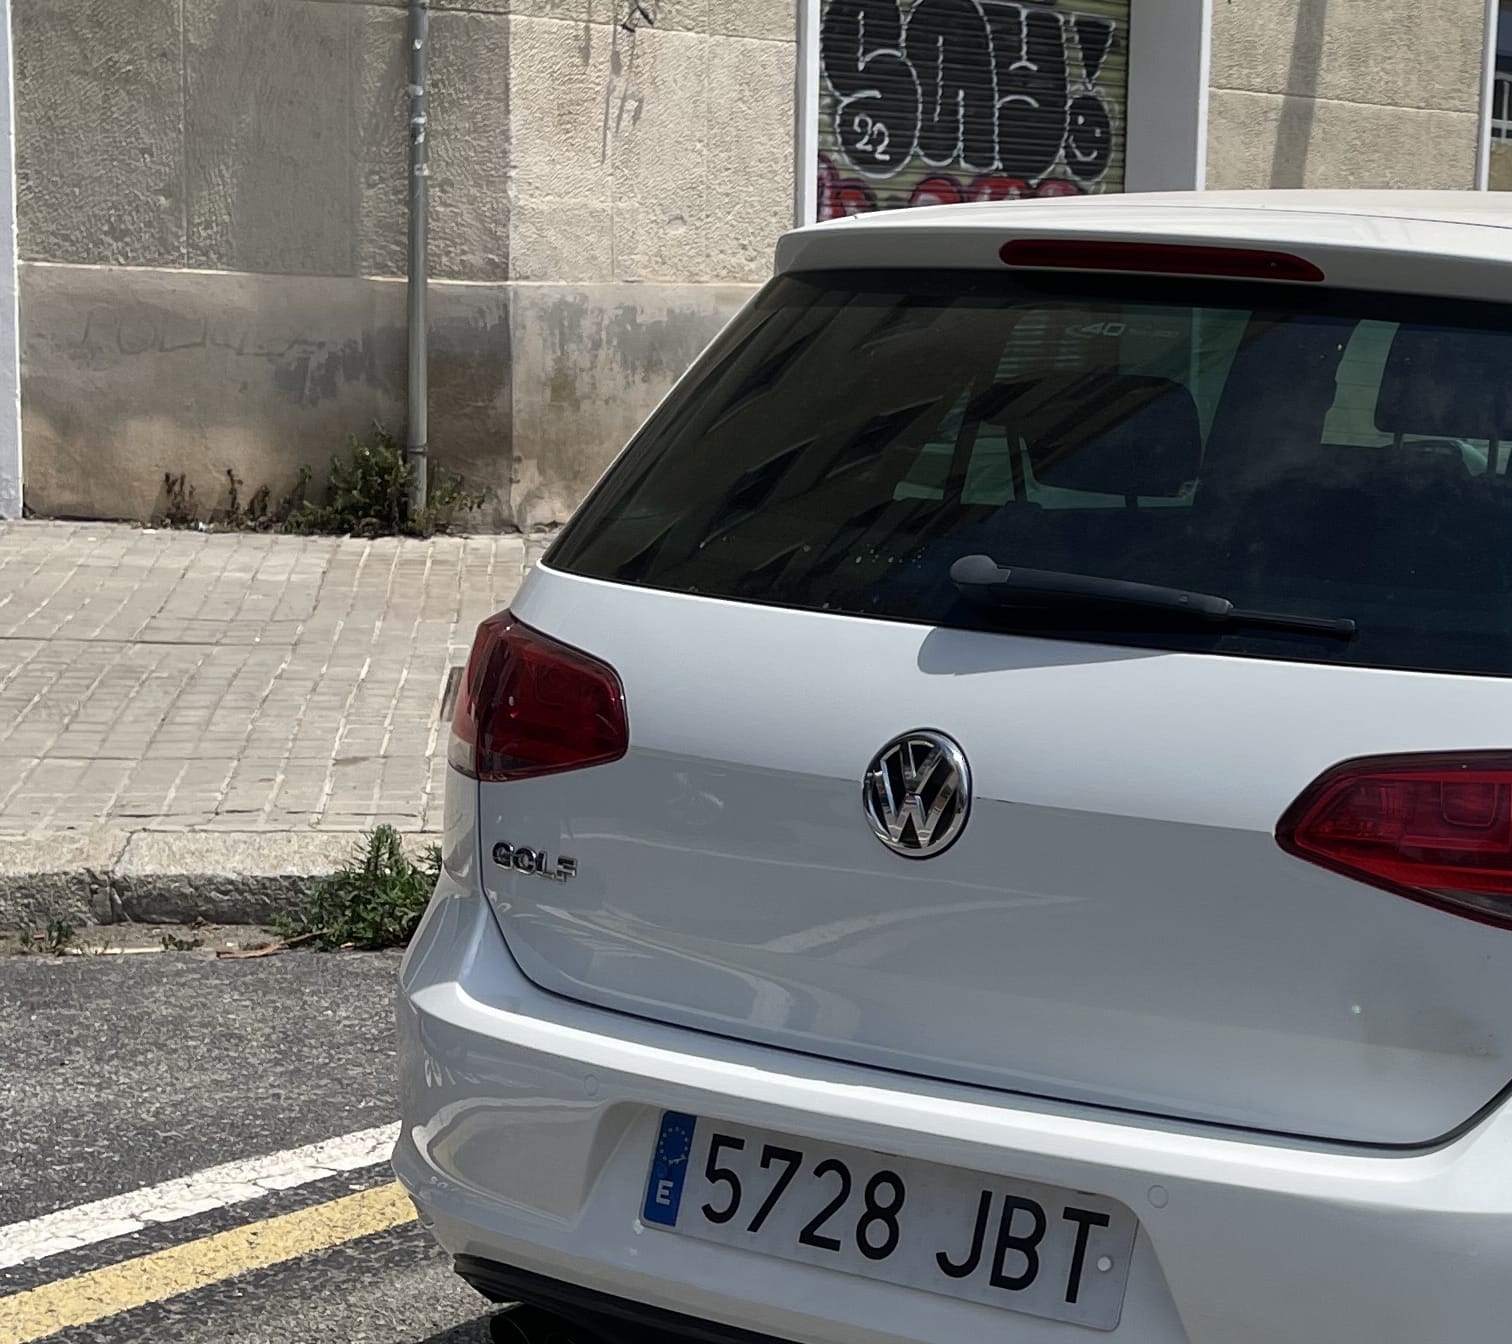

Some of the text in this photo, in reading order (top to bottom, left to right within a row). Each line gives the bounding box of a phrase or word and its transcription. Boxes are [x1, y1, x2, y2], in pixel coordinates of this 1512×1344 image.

[853, 113, 890, 161] 22
[866, 732, 970, 856] VW
[492, 841, 578, 883] GOLF
[655, 1178, 675, 1207] E
[701, 1132, 1111, 1305] 5728 JBT
